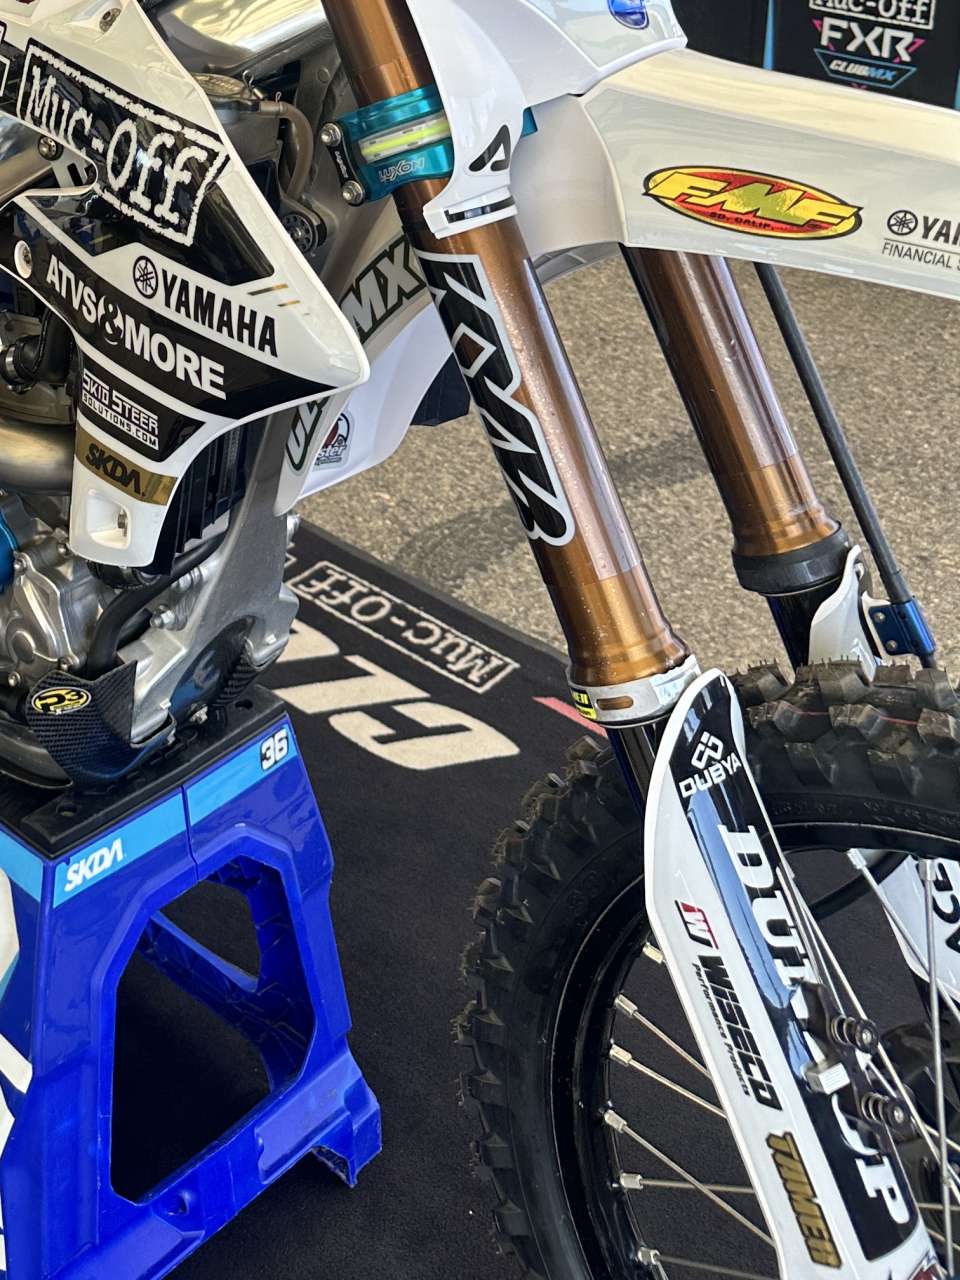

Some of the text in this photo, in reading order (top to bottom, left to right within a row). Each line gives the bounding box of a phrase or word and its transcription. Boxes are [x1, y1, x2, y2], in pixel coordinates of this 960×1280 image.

[820, 16, 915, 62] FXR
[28, 64, 209, 224] Muc-Off
[642, 171, 864, 227] FMF
[881, 241, 952, 271] FINANCIAL
[160, 268, 279, 358] YAMAHA
[82, 368, 158, 435] SKID STEER
[82, 390, 159, 450] SOLUTIONS.COM
[260, 729, 290, 771] 36
[679, 752, 742, 798] DUBYA
[64, 838, 126, 892] SKDA
[698, 954, 783, 1112] WISECO
[765, 1131, 843, 1269] TAMER
